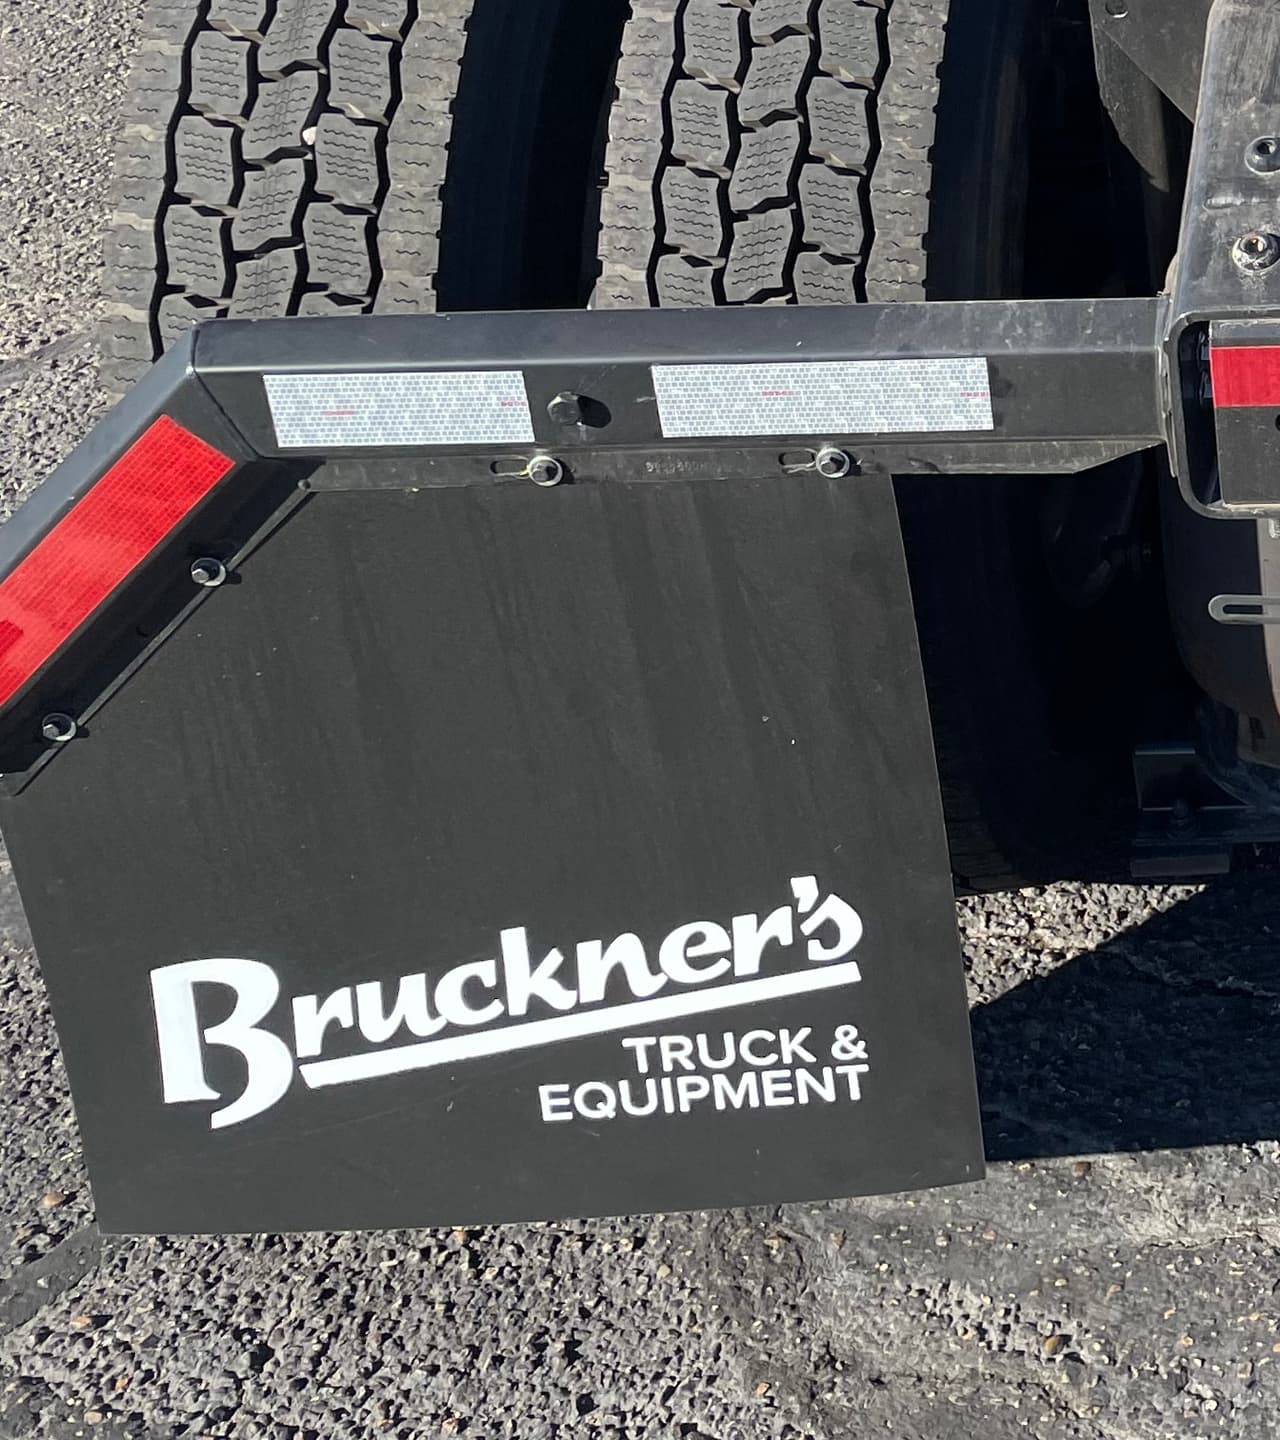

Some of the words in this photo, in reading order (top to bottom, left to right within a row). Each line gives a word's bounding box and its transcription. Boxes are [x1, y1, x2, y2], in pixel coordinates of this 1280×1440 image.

[150, 876, 863, 1129] Bruckner's
[621, 1027, 817, 1074] TRUCK
[831, 1024, 869, 1061] &
[538, 1063, 870, 1122] EQUIPMENT
